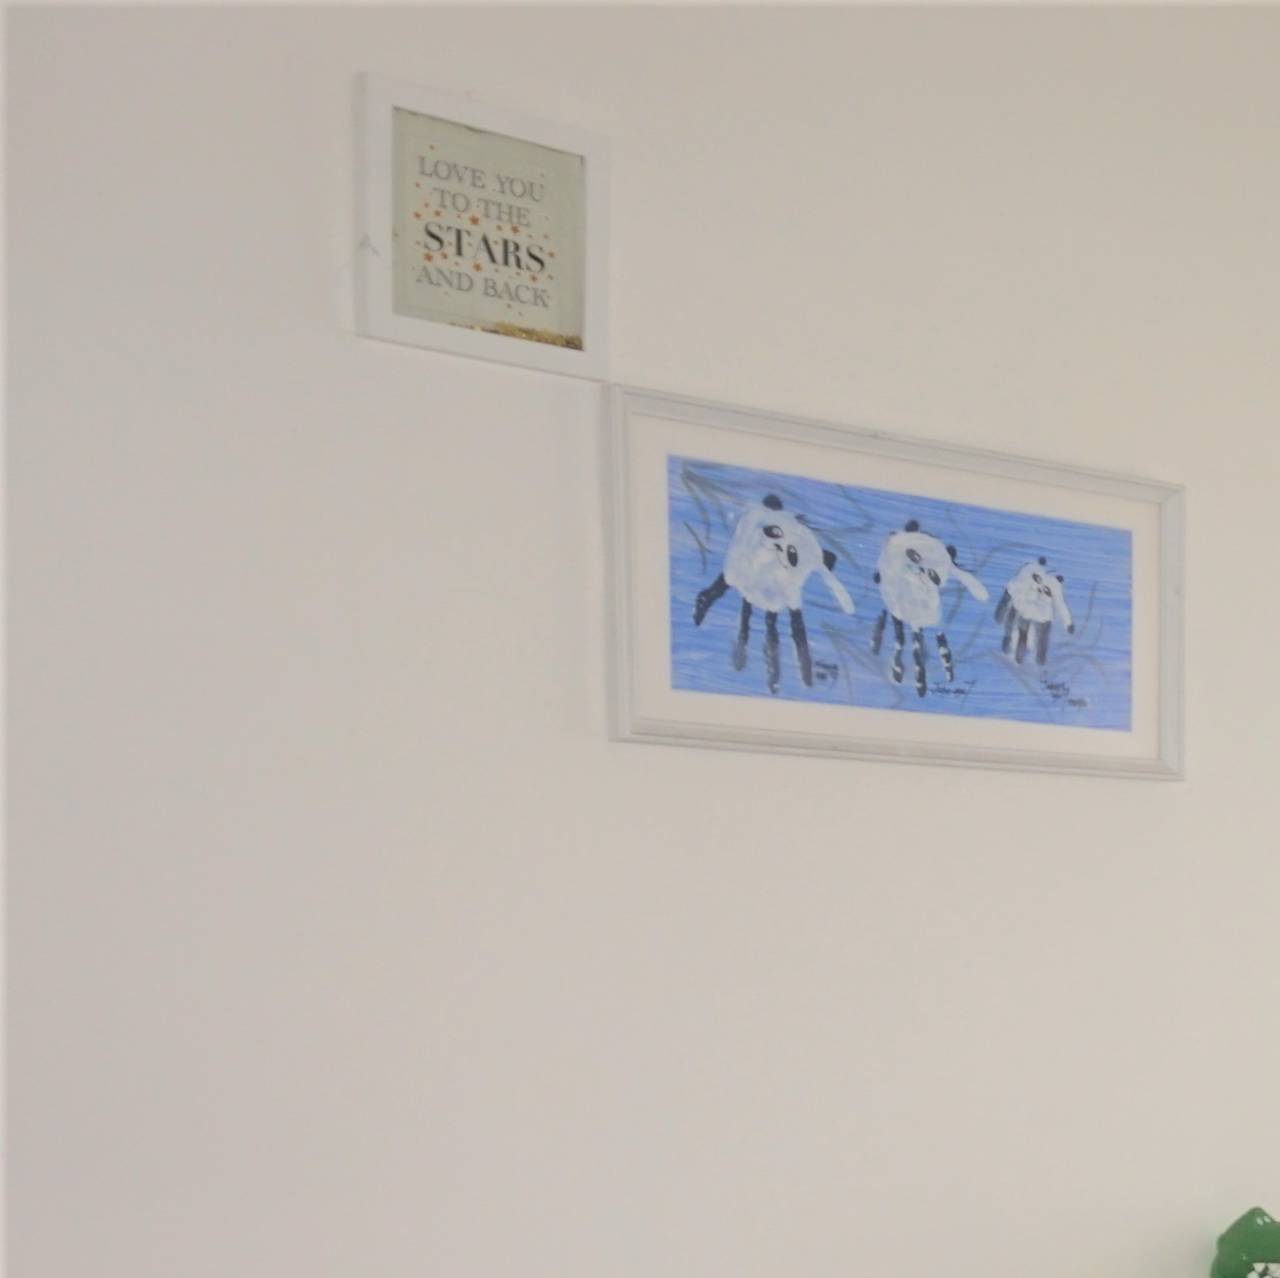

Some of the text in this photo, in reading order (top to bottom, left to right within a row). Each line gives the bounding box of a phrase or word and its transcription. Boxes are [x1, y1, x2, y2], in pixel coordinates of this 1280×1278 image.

[418, 155, 545, 202] LOVE YOU
[432, 187, 531, 228] TO THE
[423, 221, 546, 273] STARS
[415, 265, 549, 308] AND BACK
